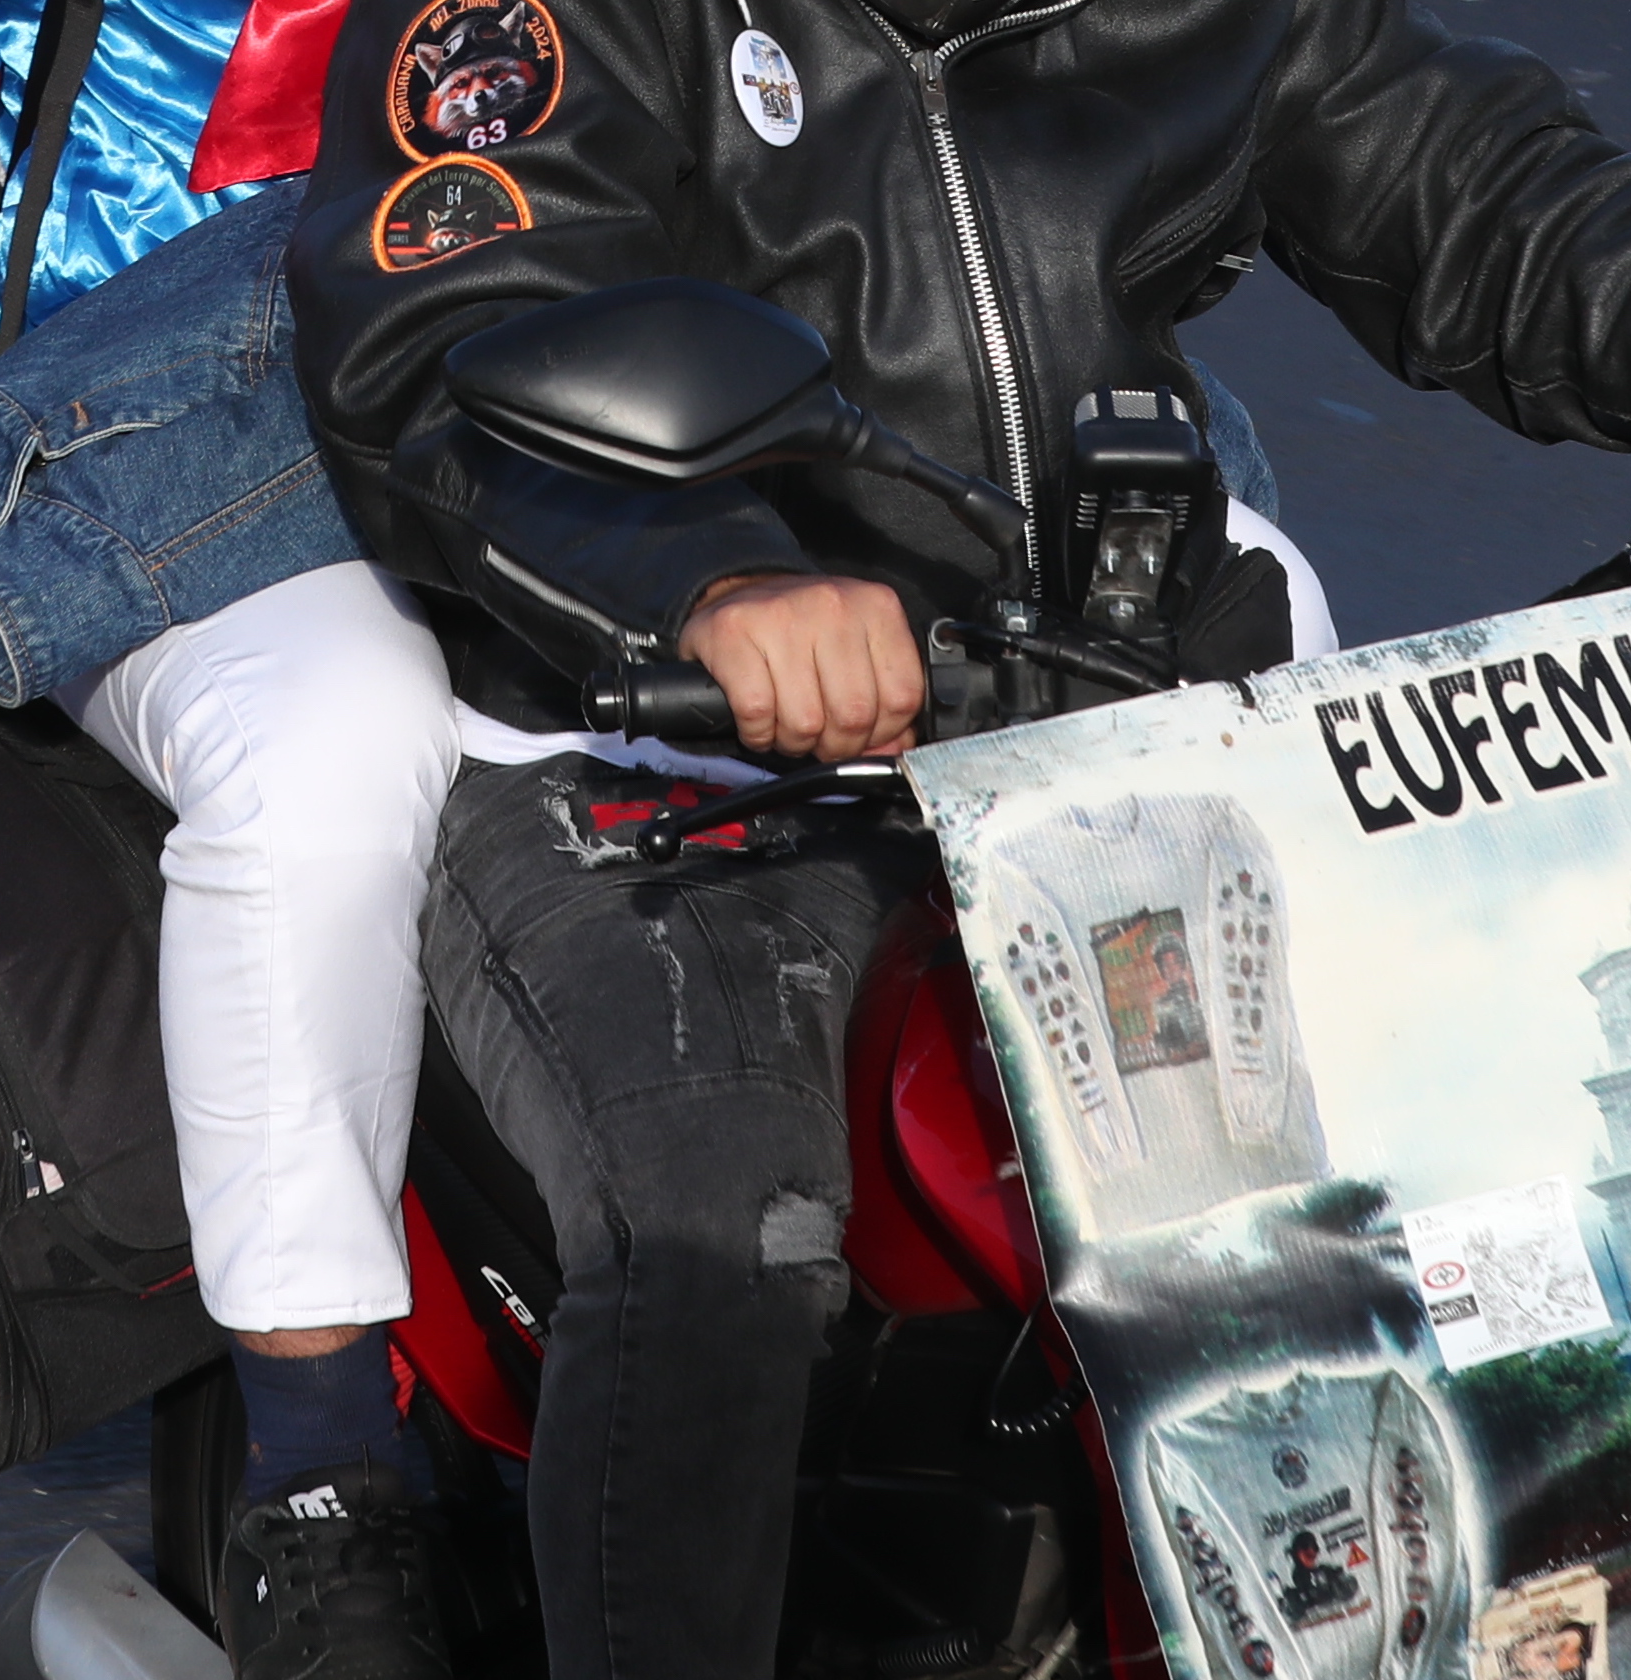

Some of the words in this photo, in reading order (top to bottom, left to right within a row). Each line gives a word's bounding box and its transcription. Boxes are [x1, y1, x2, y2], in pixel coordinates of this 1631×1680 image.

[395, 54, 417, 133] CARAVANA
[428, 6, 454, 33] DEL
[526, 17, 552, 60] 2024
[467, 118, 508, 150] 63
[446, 185, 463, 206] 64
